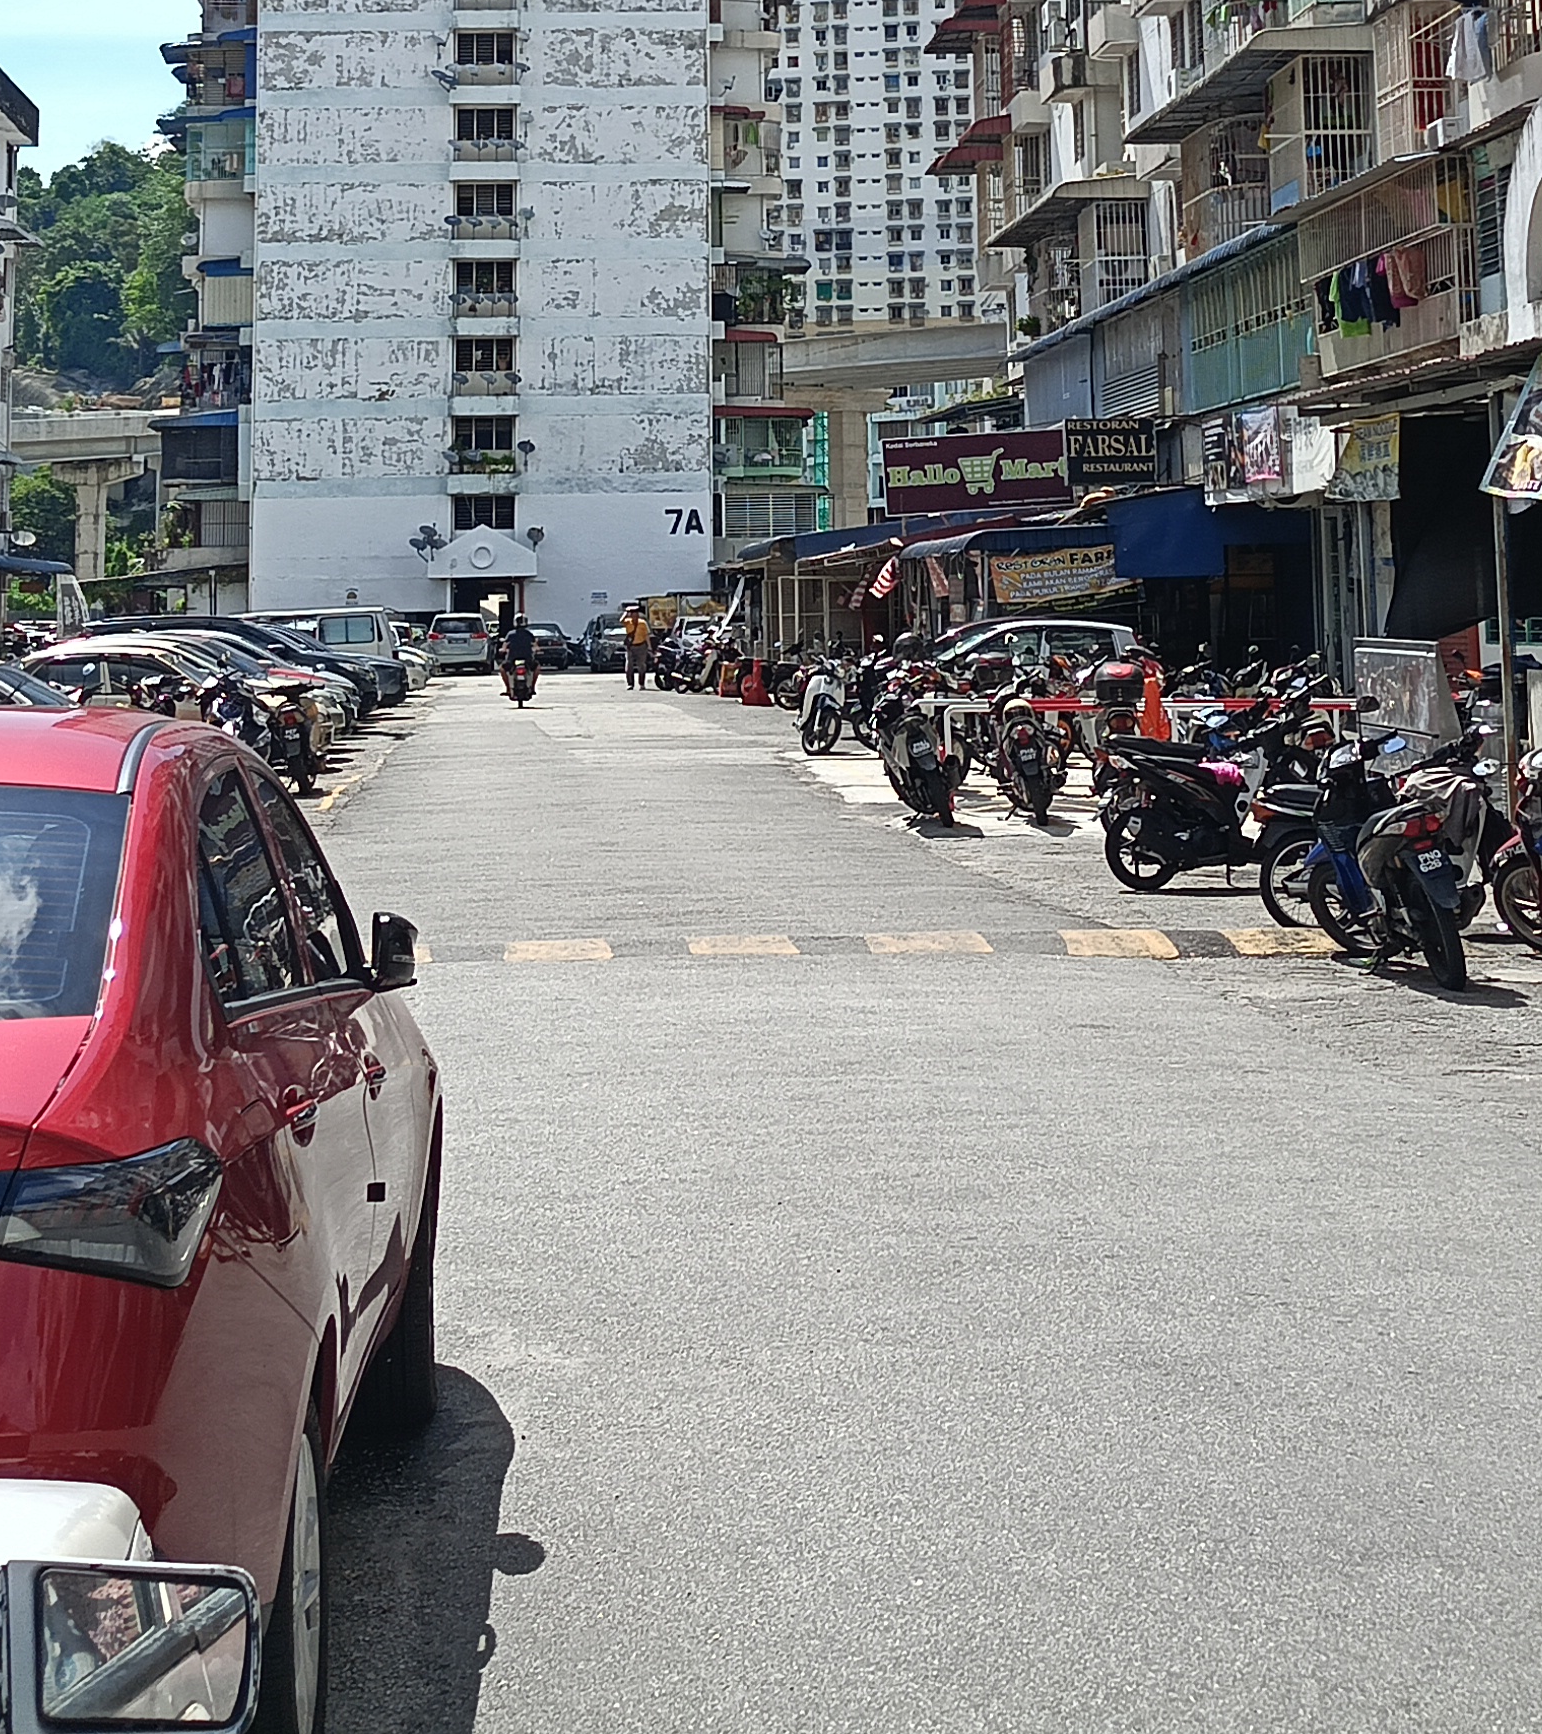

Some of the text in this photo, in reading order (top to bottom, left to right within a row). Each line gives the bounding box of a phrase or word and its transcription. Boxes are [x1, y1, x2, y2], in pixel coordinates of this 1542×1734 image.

[1067, 419, 1139, 431] RESTORAN
[1068, 433, 1156, 457] FARSAL
[887, 456, 1067, 488] Hallo Mart
[1082, 462, 1154, 474] RESTAURANT
[664, 508, 705, 535] 7A
